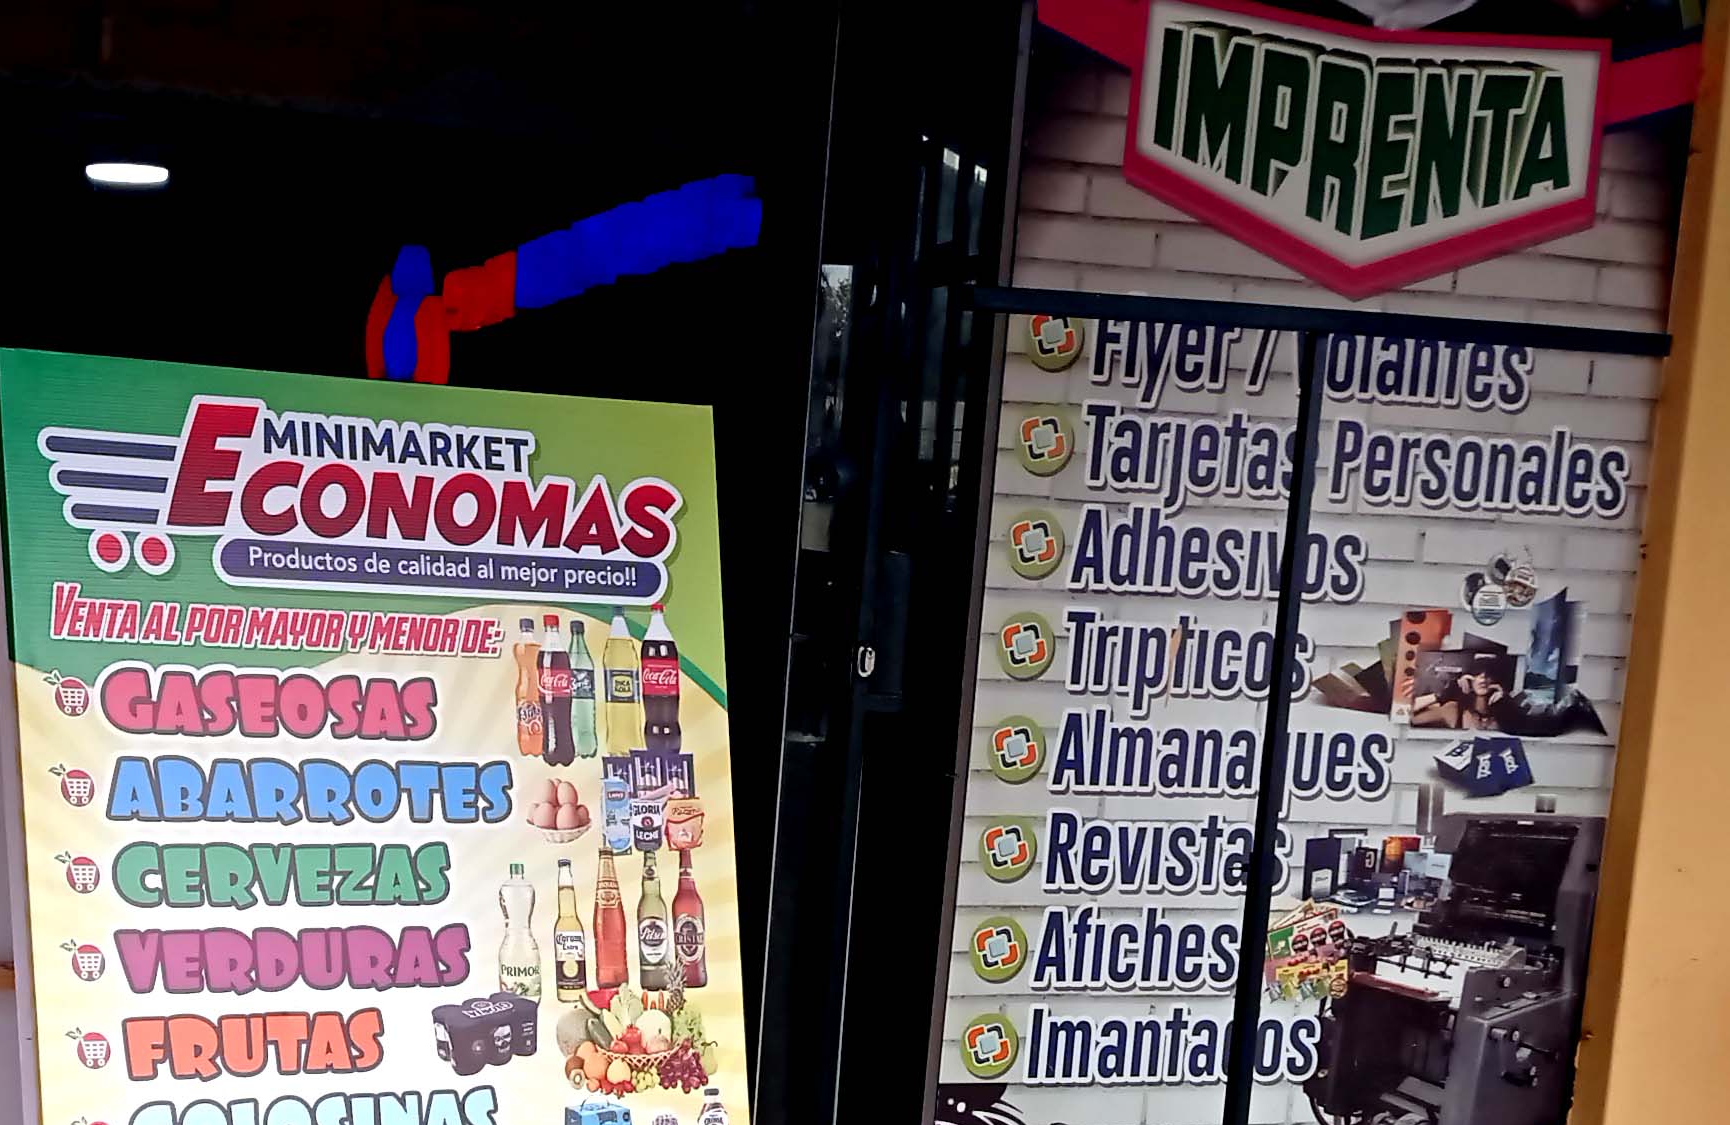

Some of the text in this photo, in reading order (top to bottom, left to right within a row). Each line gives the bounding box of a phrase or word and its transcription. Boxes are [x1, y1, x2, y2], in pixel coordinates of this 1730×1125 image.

[1153, 24, 1572, 242] IMPRENTA
[1297, 330, 1529, 405] olantes
[263, 416, 529, 474] MINIMARKET
[1331, 420, 1626, 512] Personales
[169, 403, 677, 560] ECONOMAS
[249, 547, 638, 589] Productos de calidad al mejor precio!!
[54, 584, 504, 656] VENTA AL POR MAYOR Y MENOR DE:
[102, 668, 438, 741] GASEOSAS
[106, 756, 513, 825] ABARROTES
[1052, 712, 1390, 818] Almanaues
[633, 803, 661, 817] GLORIA
[635, 830, 659, 841] LECHE
[112, 840, 451, 911] CERVEZAS
[114, 924, 471, 994] VERDURAS
[501, 964, 541, 977] PRIMOR
[1034, 909, 1238, 984] Afiches
[122, 1008, 385, 1082] FRUTAS
[1026, 1008, 1318, 1082] Imantaos
